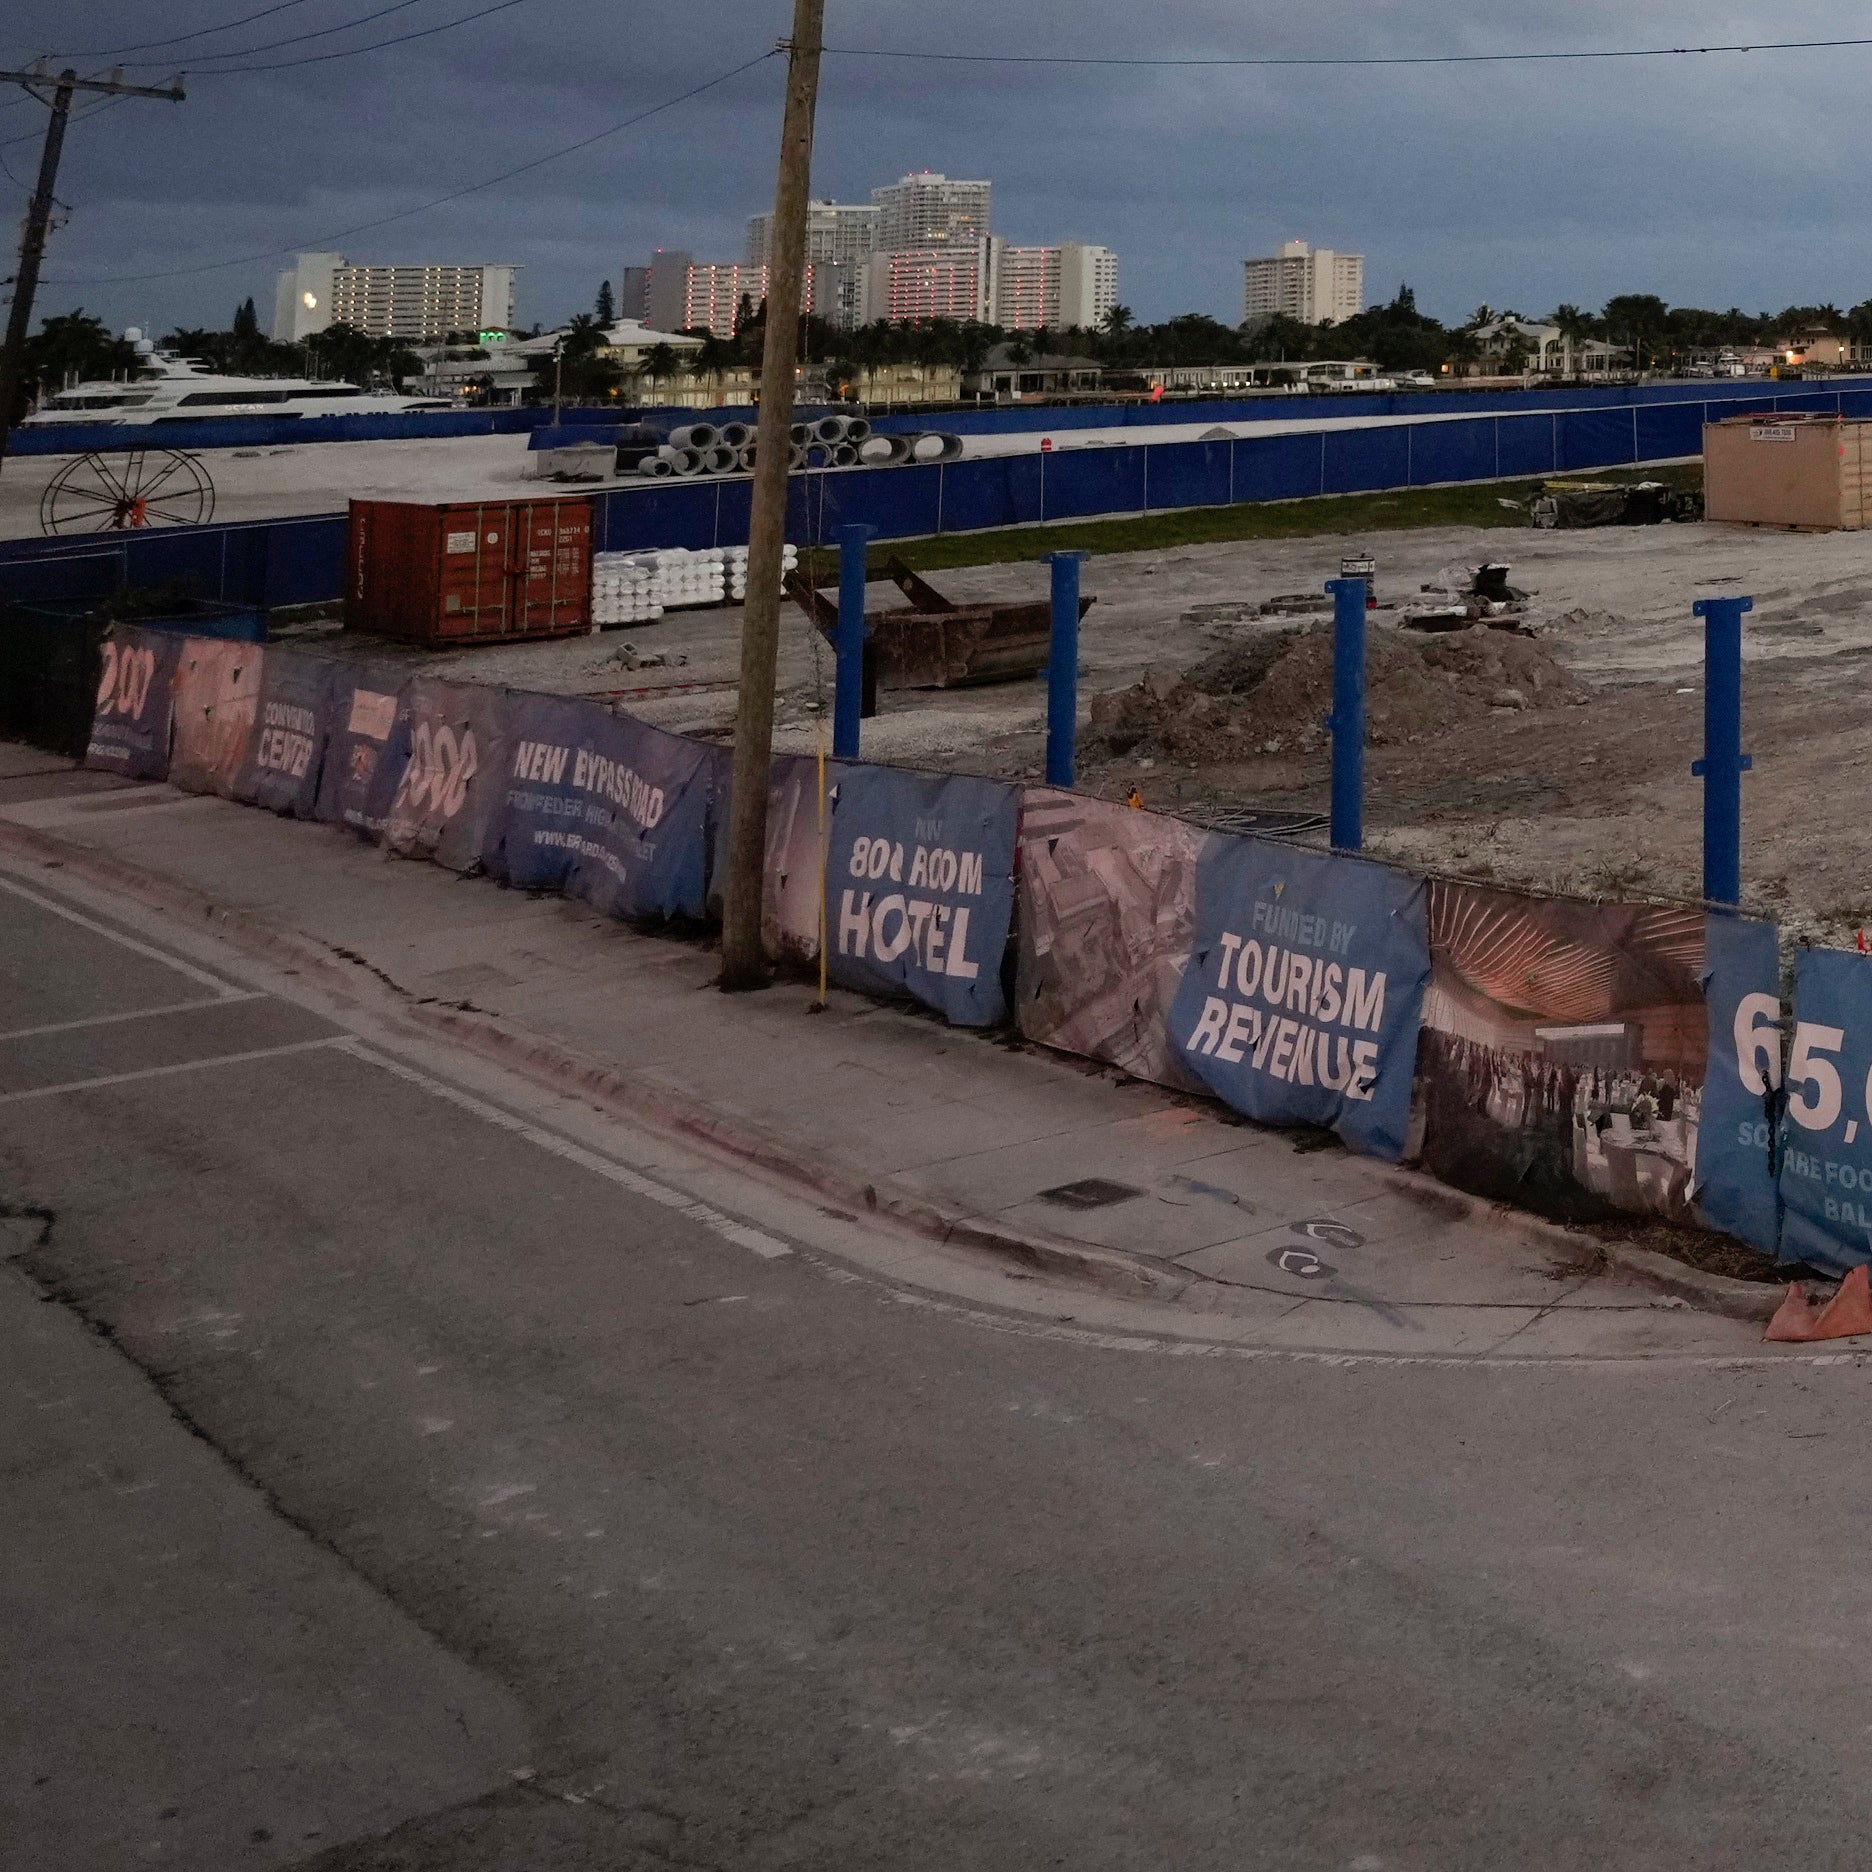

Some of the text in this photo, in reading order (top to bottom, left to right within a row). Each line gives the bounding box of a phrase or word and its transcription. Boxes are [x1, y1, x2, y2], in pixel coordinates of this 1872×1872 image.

[513, 740, 570, 785] NEW
[573, 747, 633, 808] BYPASS
[908, 844, 983, 896] ROOM
[839, 889, 980, 979] HOTEL
[1329, 920, 1357, 956] BY
[1217, 931, 1388, 1033] TOURISM
[1186, 995, 1380, 1102] REVENUE
[1737, 1121, 1822, 1178] SQARE
